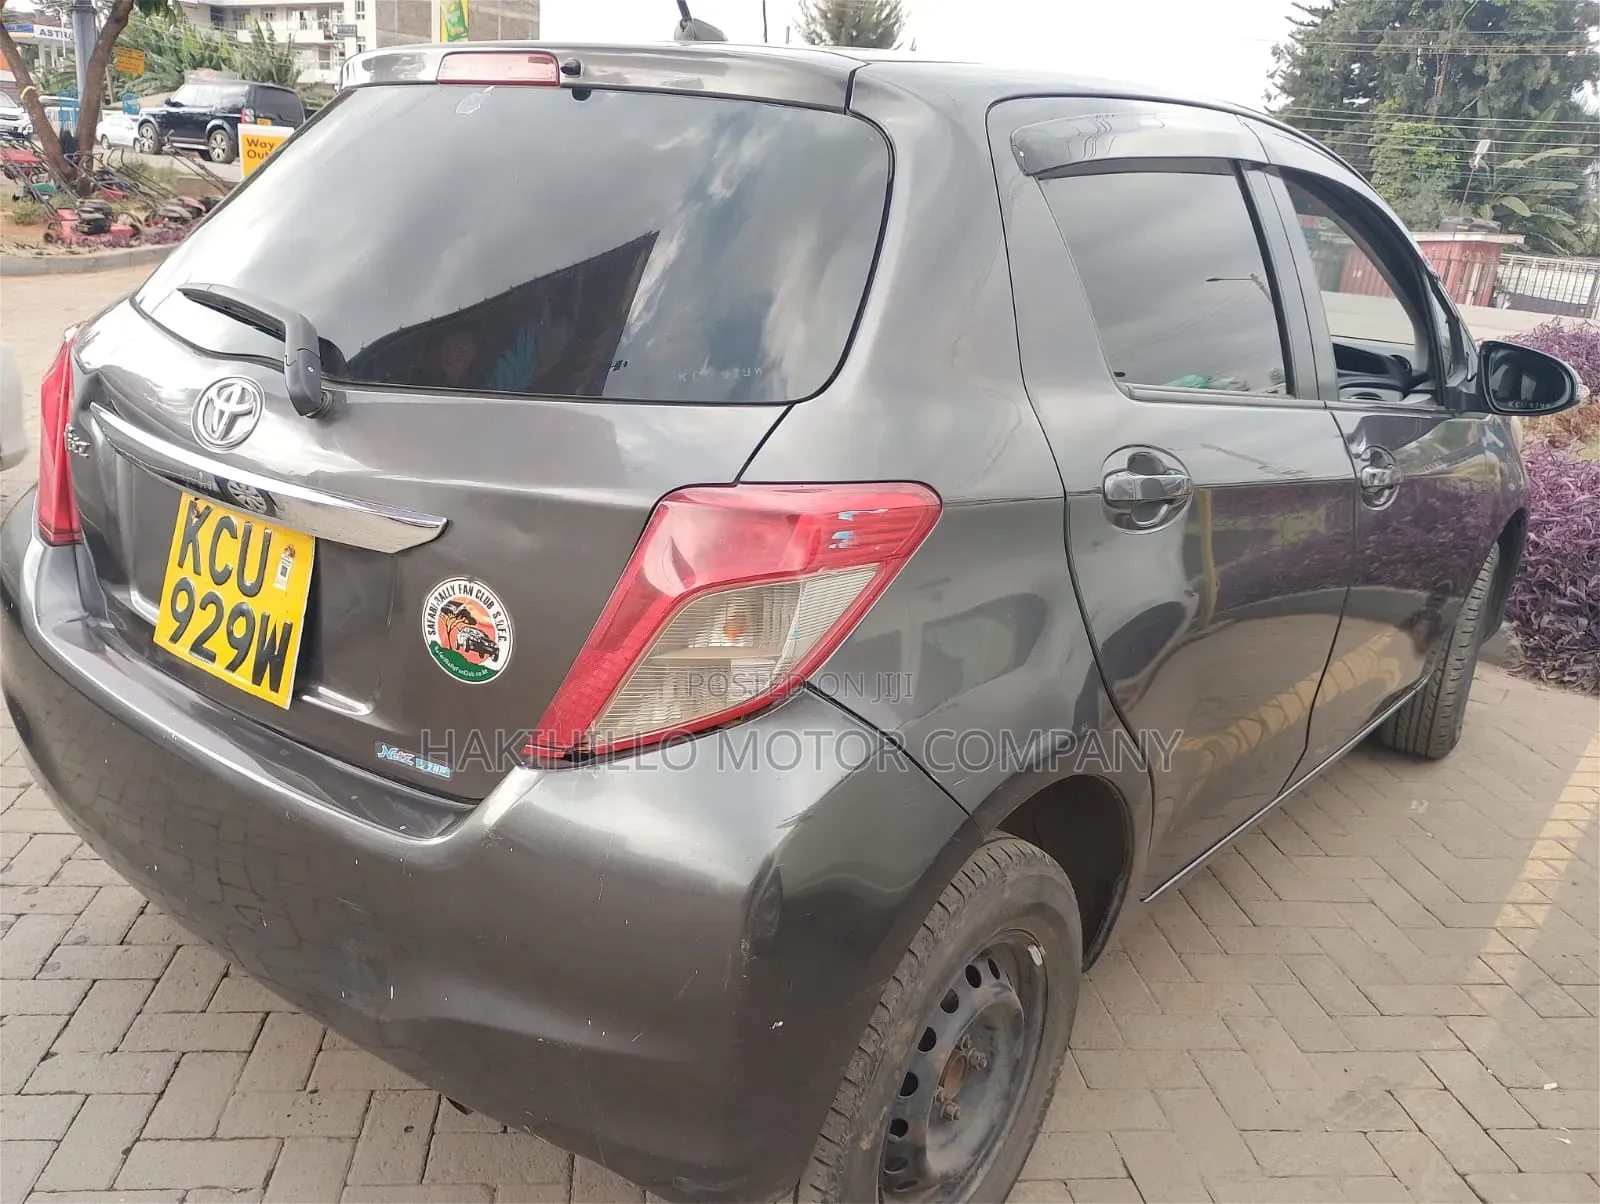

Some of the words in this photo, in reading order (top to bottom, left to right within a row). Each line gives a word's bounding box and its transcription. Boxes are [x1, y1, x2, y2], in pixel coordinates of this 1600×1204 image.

[246, 138, 275, 151] Way
[177, 499, 273, 598] KCU
[458, 583, 474, 597] FAN
[475, 589, 494, 610] CLUB
[168, 576, 294, 694] 929W
